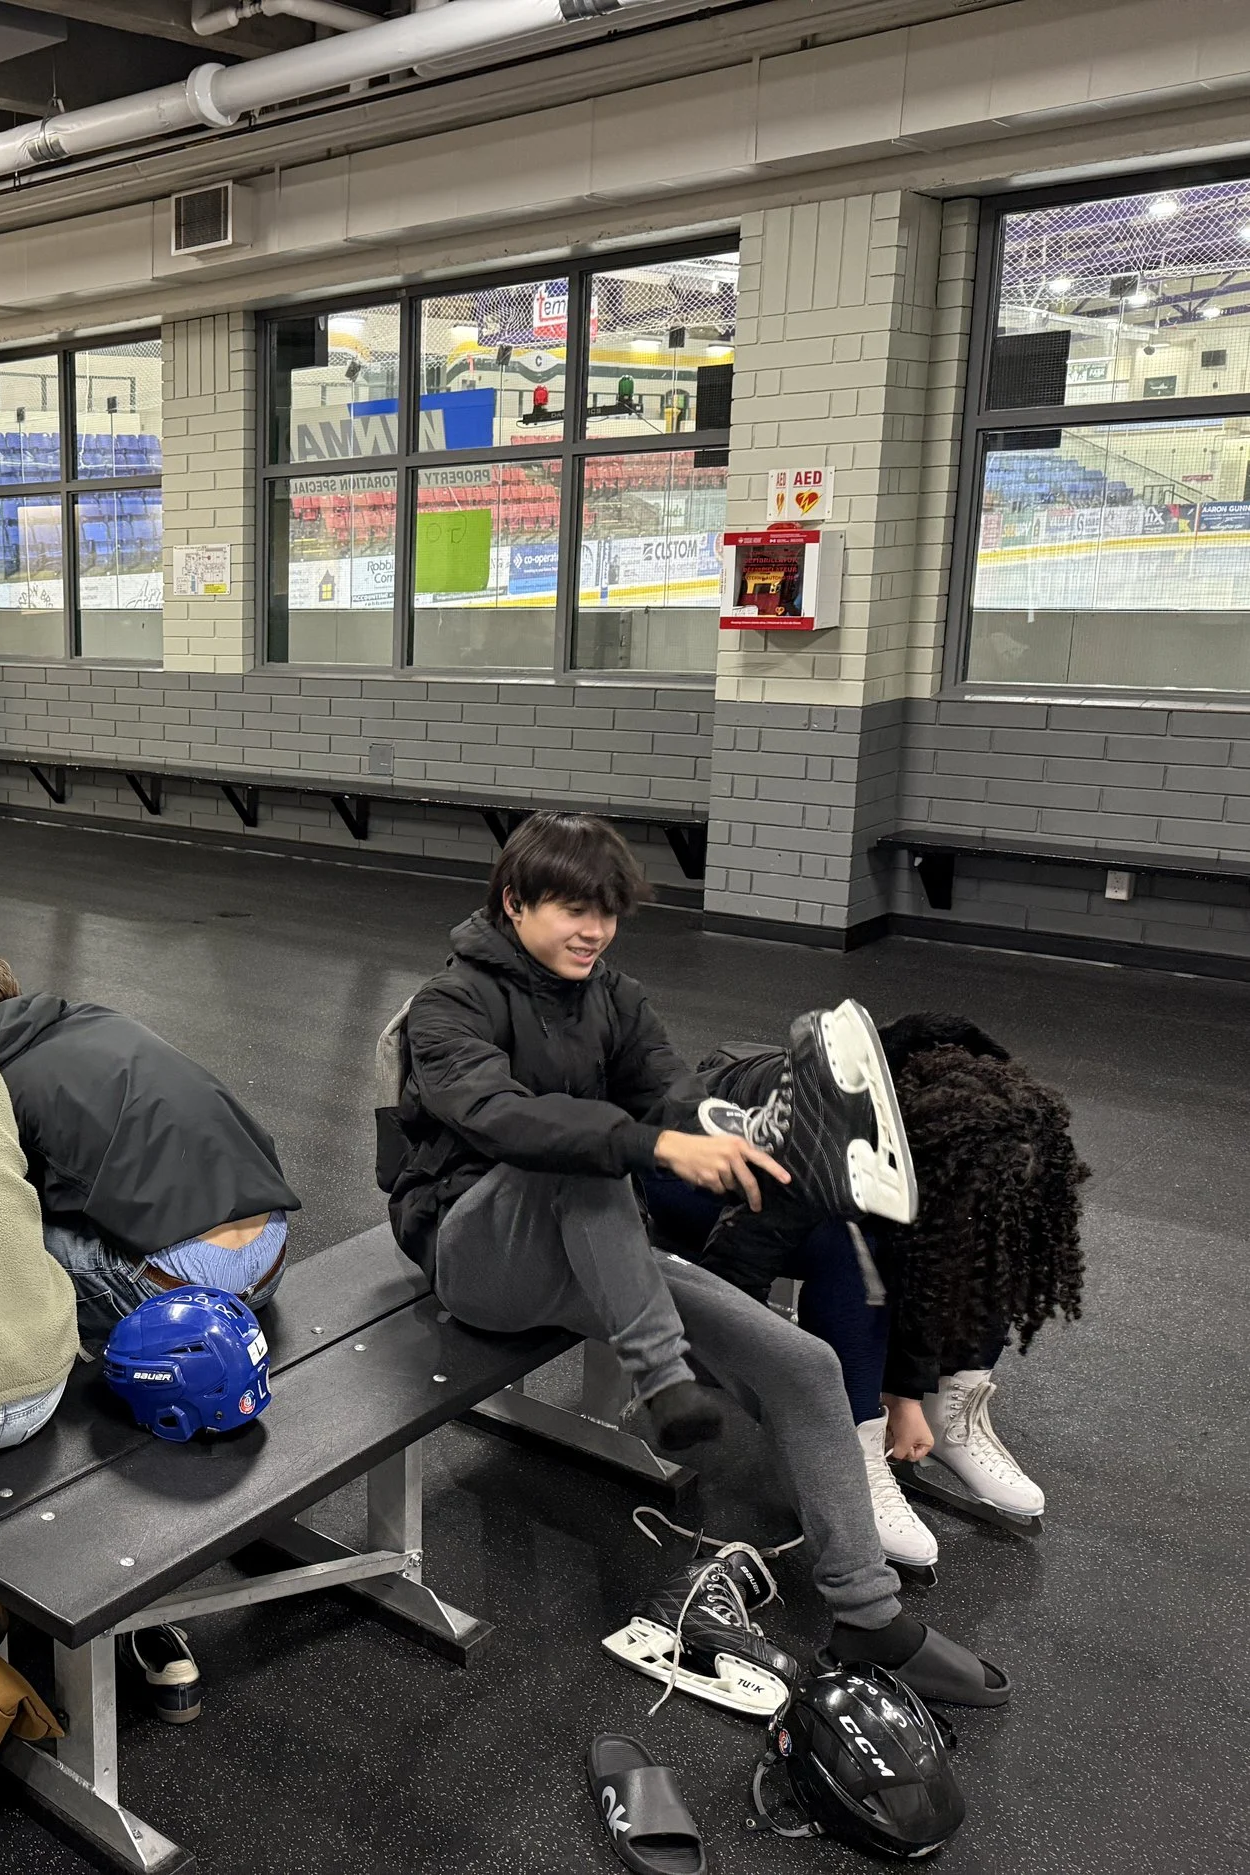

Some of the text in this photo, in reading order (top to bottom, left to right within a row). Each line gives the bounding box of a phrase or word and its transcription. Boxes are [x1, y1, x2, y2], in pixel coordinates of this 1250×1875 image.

[793, 470, 823, 485] AED
[1201, 506, 1227, 514] AARON
[654, 540, 698, 560] CUSTOM
[366, 559, 394, 574] Robbi
[133, 1371, 173, 1382] BAUER
[838, 1715, 896, 1777] CCM
